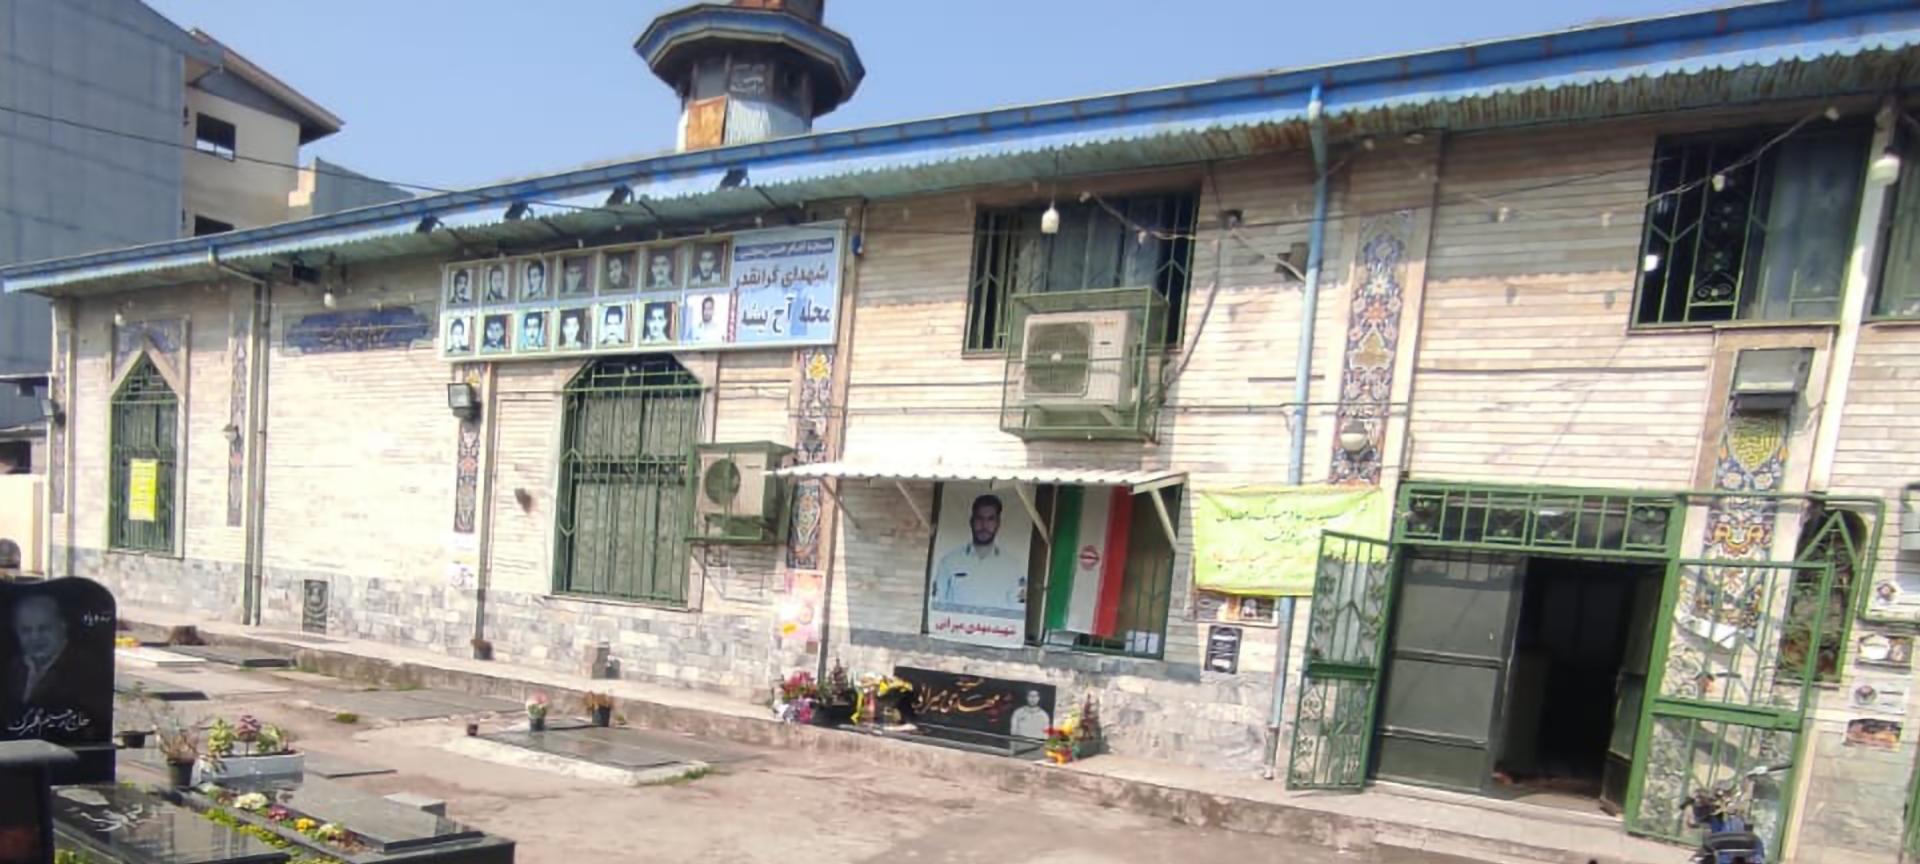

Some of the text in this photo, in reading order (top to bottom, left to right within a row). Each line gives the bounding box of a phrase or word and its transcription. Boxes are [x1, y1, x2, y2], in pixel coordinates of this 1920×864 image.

[735, 263, 829, 291] شهدای گرانقدر
[799, 299, 831, 323] محله
